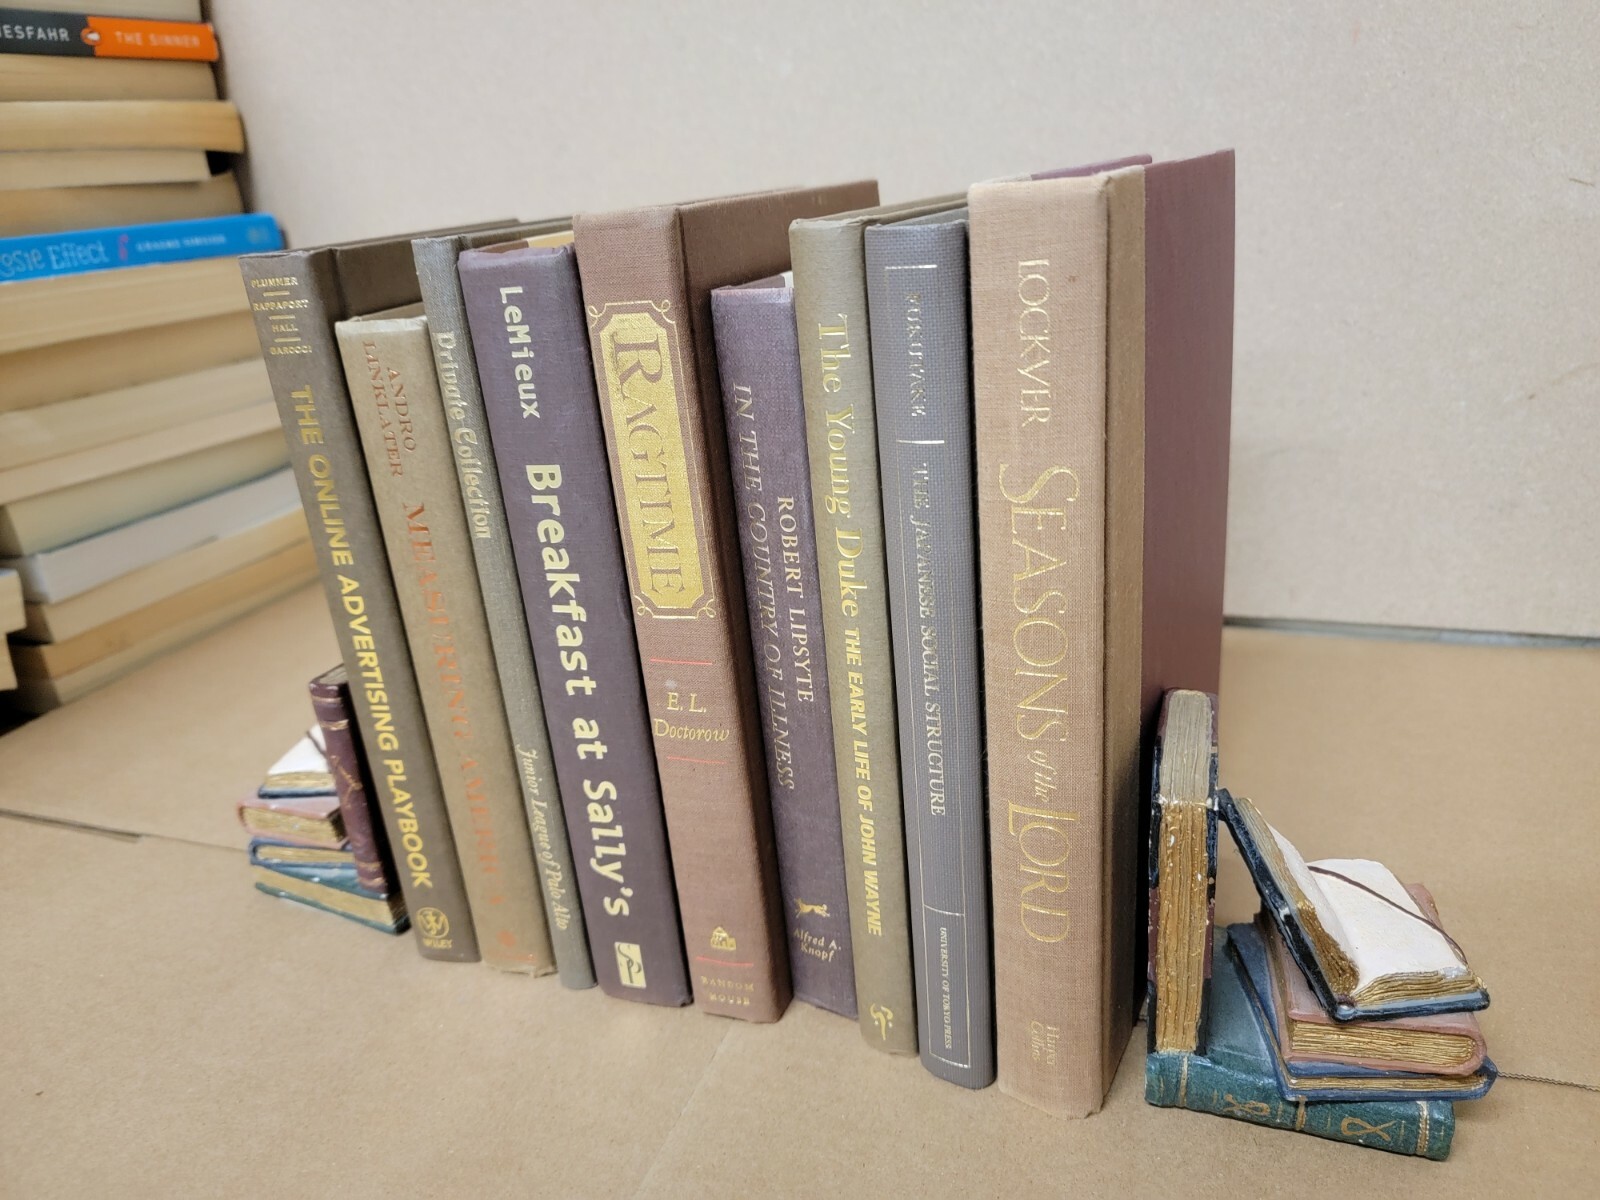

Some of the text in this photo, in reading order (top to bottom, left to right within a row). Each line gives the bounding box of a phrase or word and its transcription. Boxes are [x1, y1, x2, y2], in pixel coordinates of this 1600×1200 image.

[0, 24, 70, 42] ESFAHR
[272, 323, 299, 332] HALL
[500, 286, 541, 419] LeMieux
[1017, 258, 1051, 428] LOCKYER
[362, 340, 404, 478] LINKLATER
[387, 367, 416, 452] ANDRO
[610, 330, 686, 595] RAGTIME
[454, 427, 492, 539] Collection
[291, 384, 433, 889] THE ONLINE ADVERTISING PLAYBOOK
[733, 382, 795, 791] IN THE COUNTRY OF ILLNESS
[777, 496, 815, 703] ROBERT LIPSYTE
[818, 313, 882, 937] The Young Duke THE EARLY LIFE OF JOHN WAYNE
[910, 462, 946, 817] THE JAPANESE SOCIAL STRUCTURE
[998, 462, 1081, 743] SEASONS
[525, 464, 635, 917] Breakfast at Sally's
[653, 718, 730, 742] Doctorow
[667, 691, 707, 713] E. L.
[1026, 749, 1058, 775] of
[531, 798, 551, 850] League
[1007, 799, 1080, 943] LORD
[545, 865, 566, 899] Palo
[551, 900, 572, 931] Alto
[793, 928, 842, 951] Alfred A.
[800, 942, 835, 963] Knopf
[942, 979, 951, 994] OF
